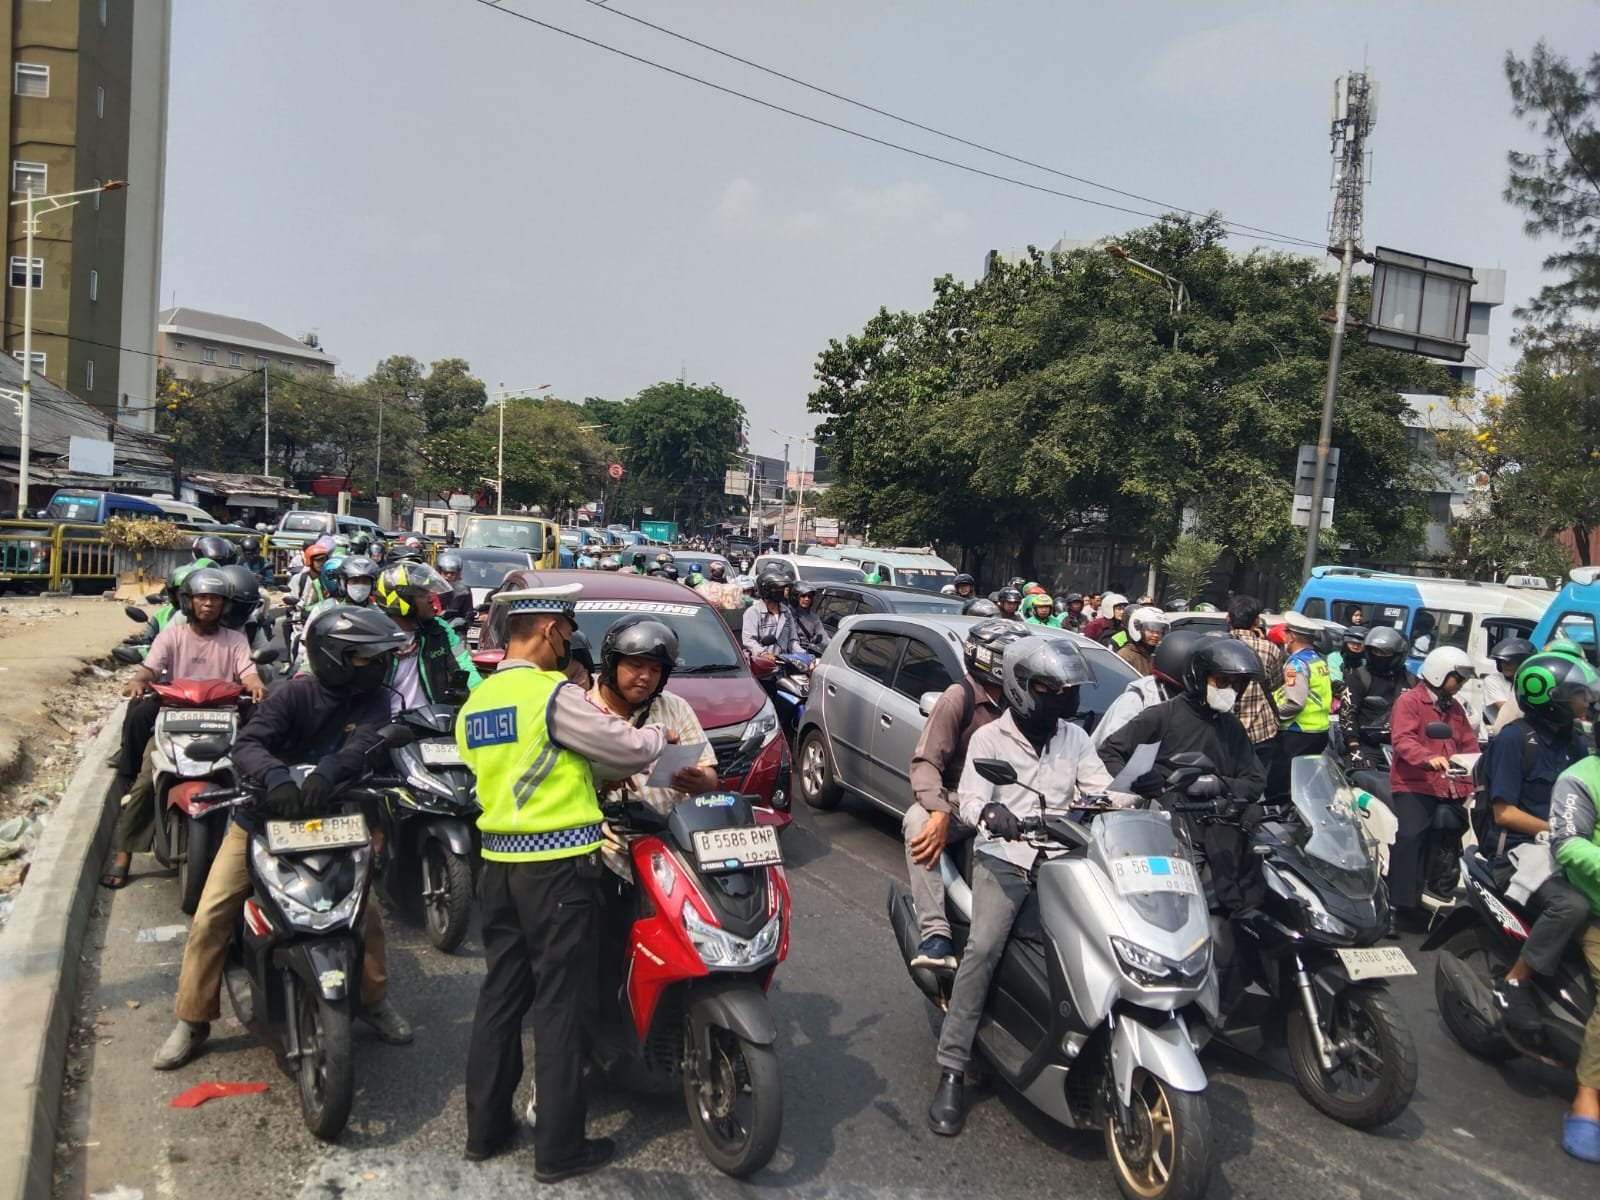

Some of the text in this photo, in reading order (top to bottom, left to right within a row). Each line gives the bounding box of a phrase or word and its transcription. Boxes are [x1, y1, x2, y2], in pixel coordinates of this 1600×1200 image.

[466, 712, 514, 741] POLISI
[273, 824, 280, 835] B
[702, 829, 772, 850] B 5586 BNP
[1116, 863, 1124, 876] B
